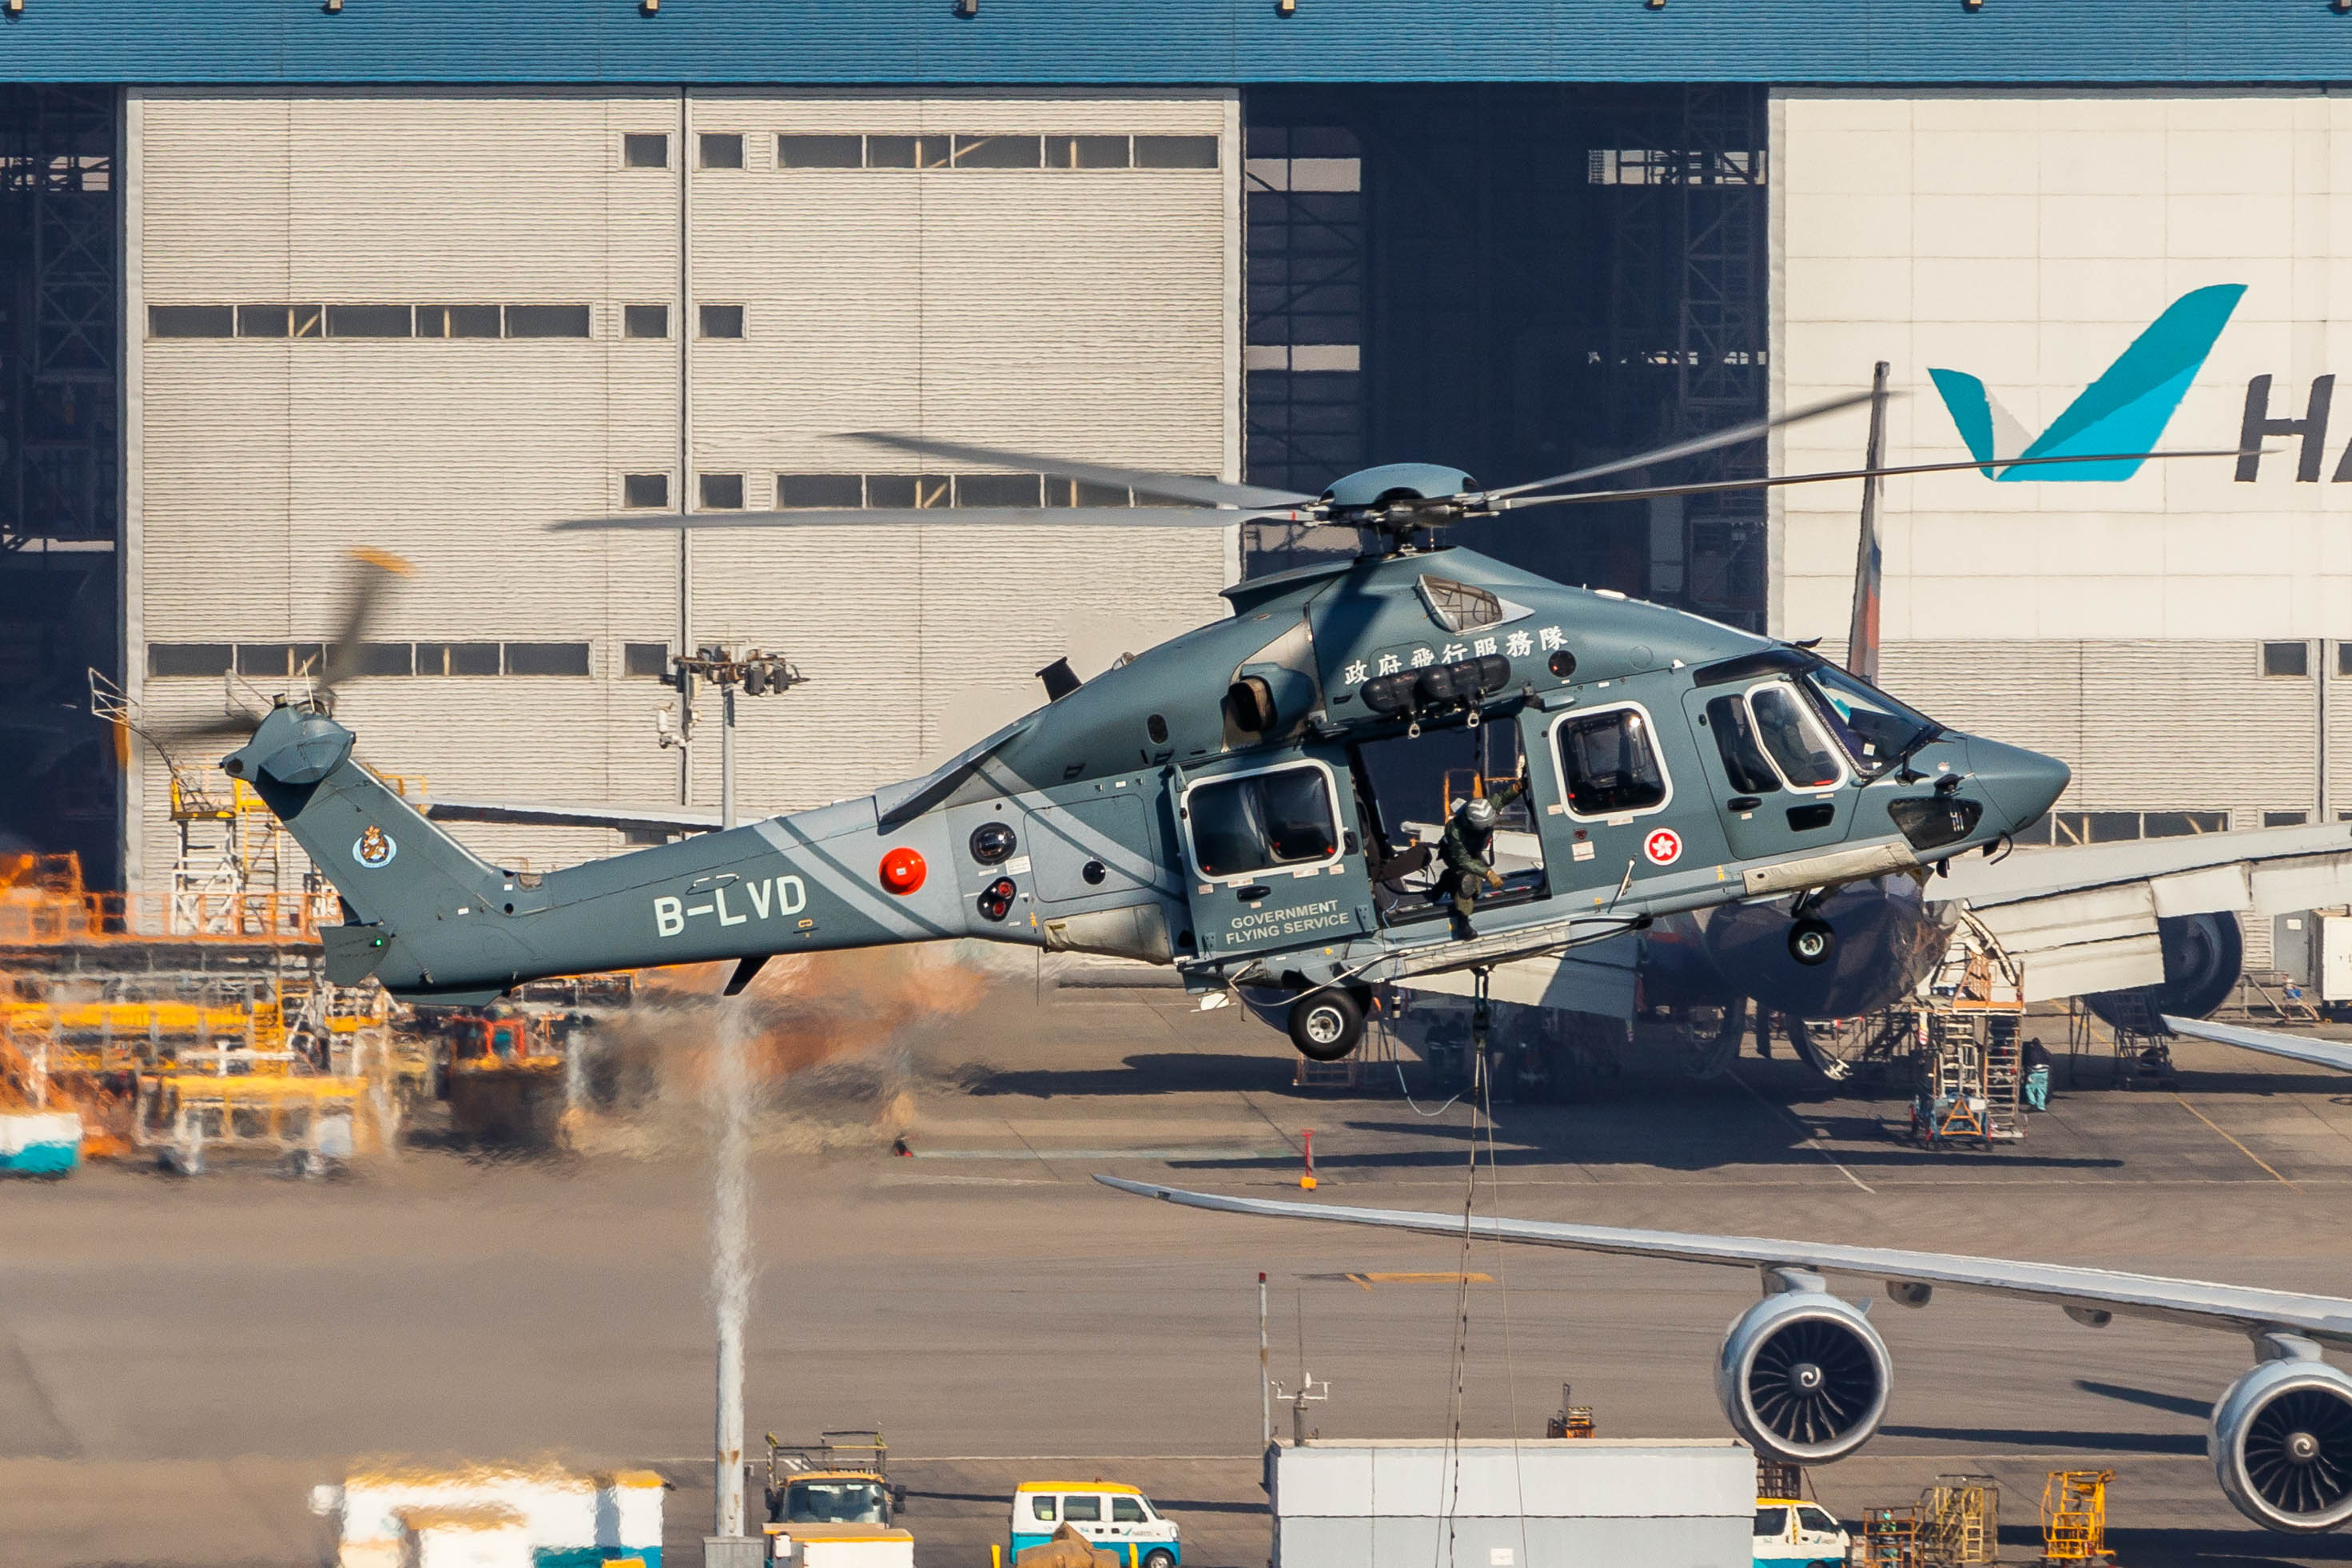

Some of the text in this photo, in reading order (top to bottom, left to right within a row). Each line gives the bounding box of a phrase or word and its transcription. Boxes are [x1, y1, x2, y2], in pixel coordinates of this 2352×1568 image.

[2234, 374, 2352, 482] H
[1344, 625, 1568, 685] 政府飛行服務隊
[654, 875, 806, 937] B-LVD
[1225, 913, 1350, 945] FLYING SERVICE
[1231, 899, 1339, 929] GOVERNMENT
